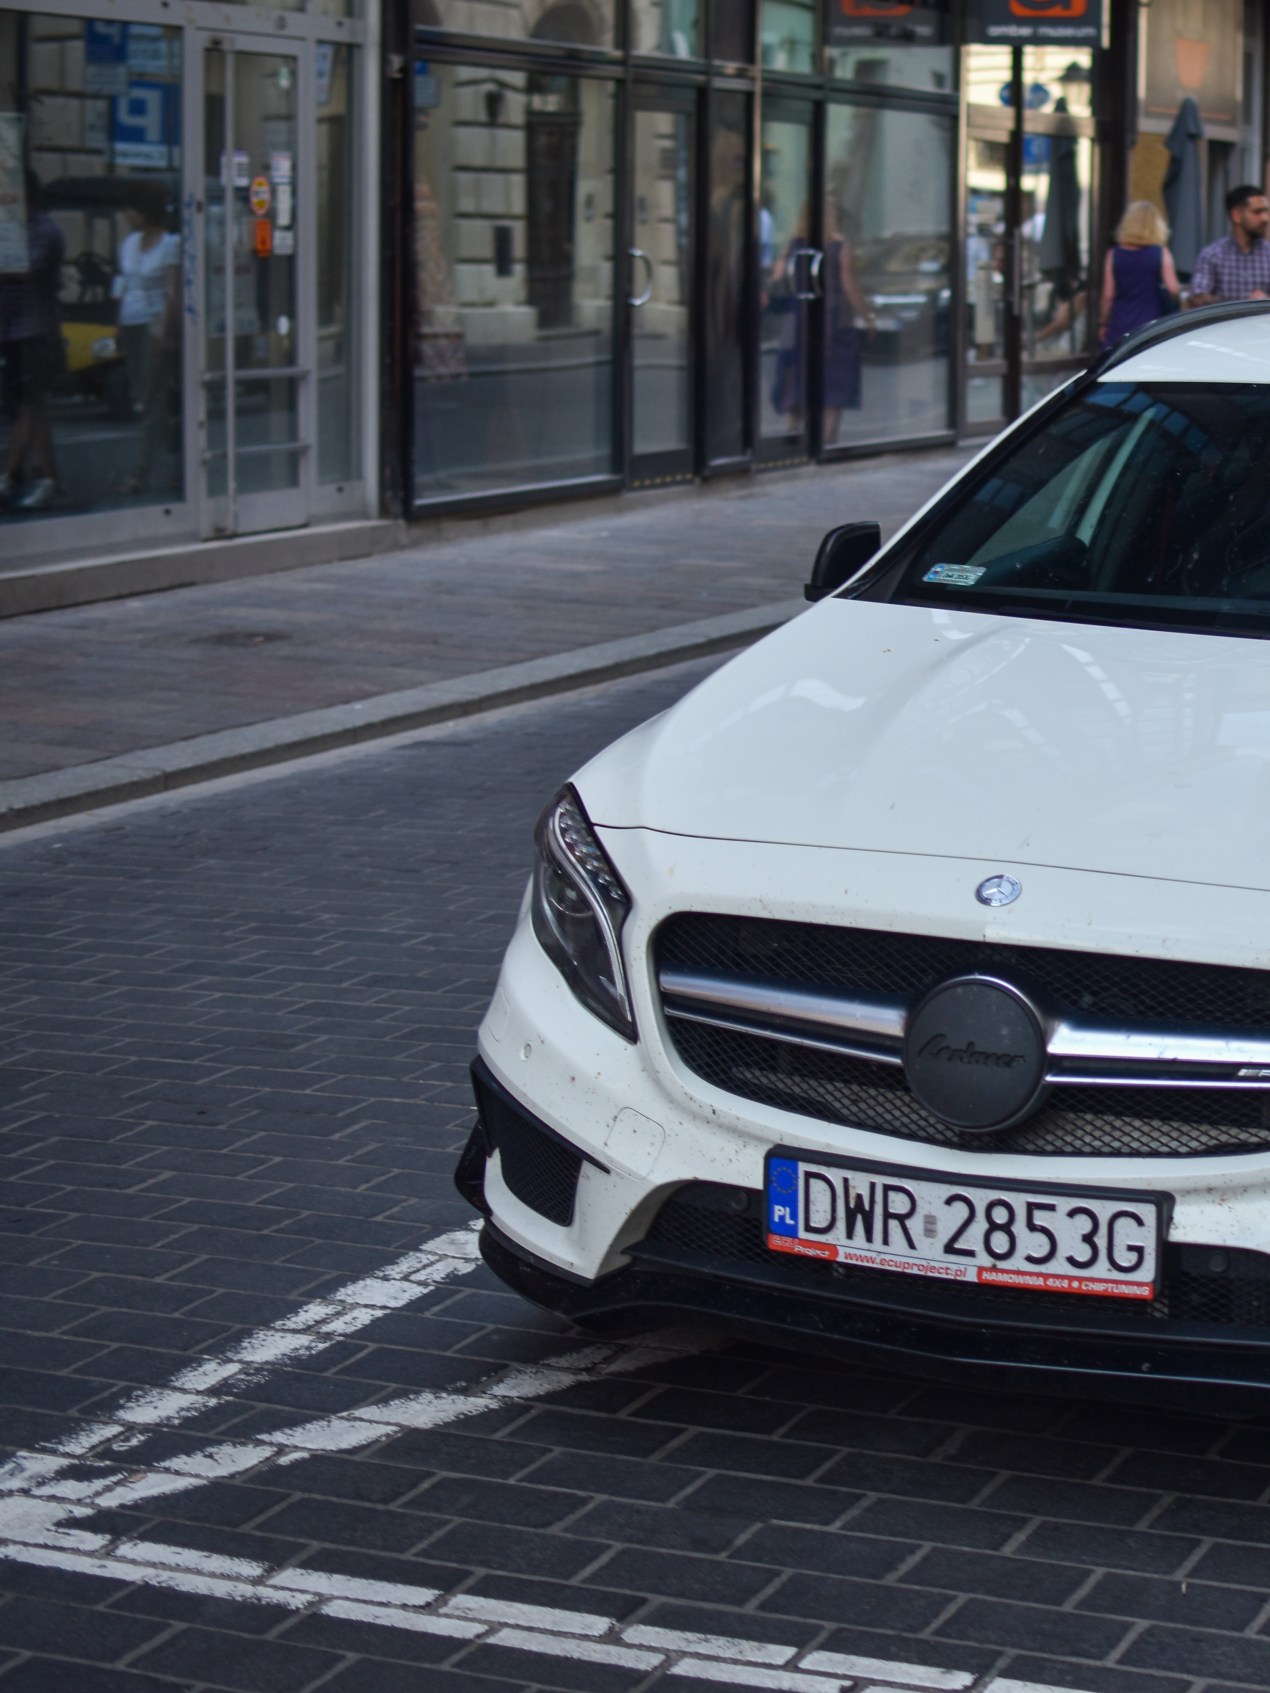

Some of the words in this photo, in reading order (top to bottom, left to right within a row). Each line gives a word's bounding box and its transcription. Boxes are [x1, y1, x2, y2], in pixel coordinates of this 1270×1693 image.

[986, 24, 1034, 37] amber
[1038, 25, 1096, 38] museum
[772, 1205, 796, 1226] PL
[802, 1169, 918, 1251] DWR
[943, 1192, 1146, 1274] 2853G
[843, 1250, 968, 1280] www.ecuproject.pl
[981, 1270, 1044, 1287] HAMOWNIA
[1081, 1282, 1150, 1297] CHIPTUNING
